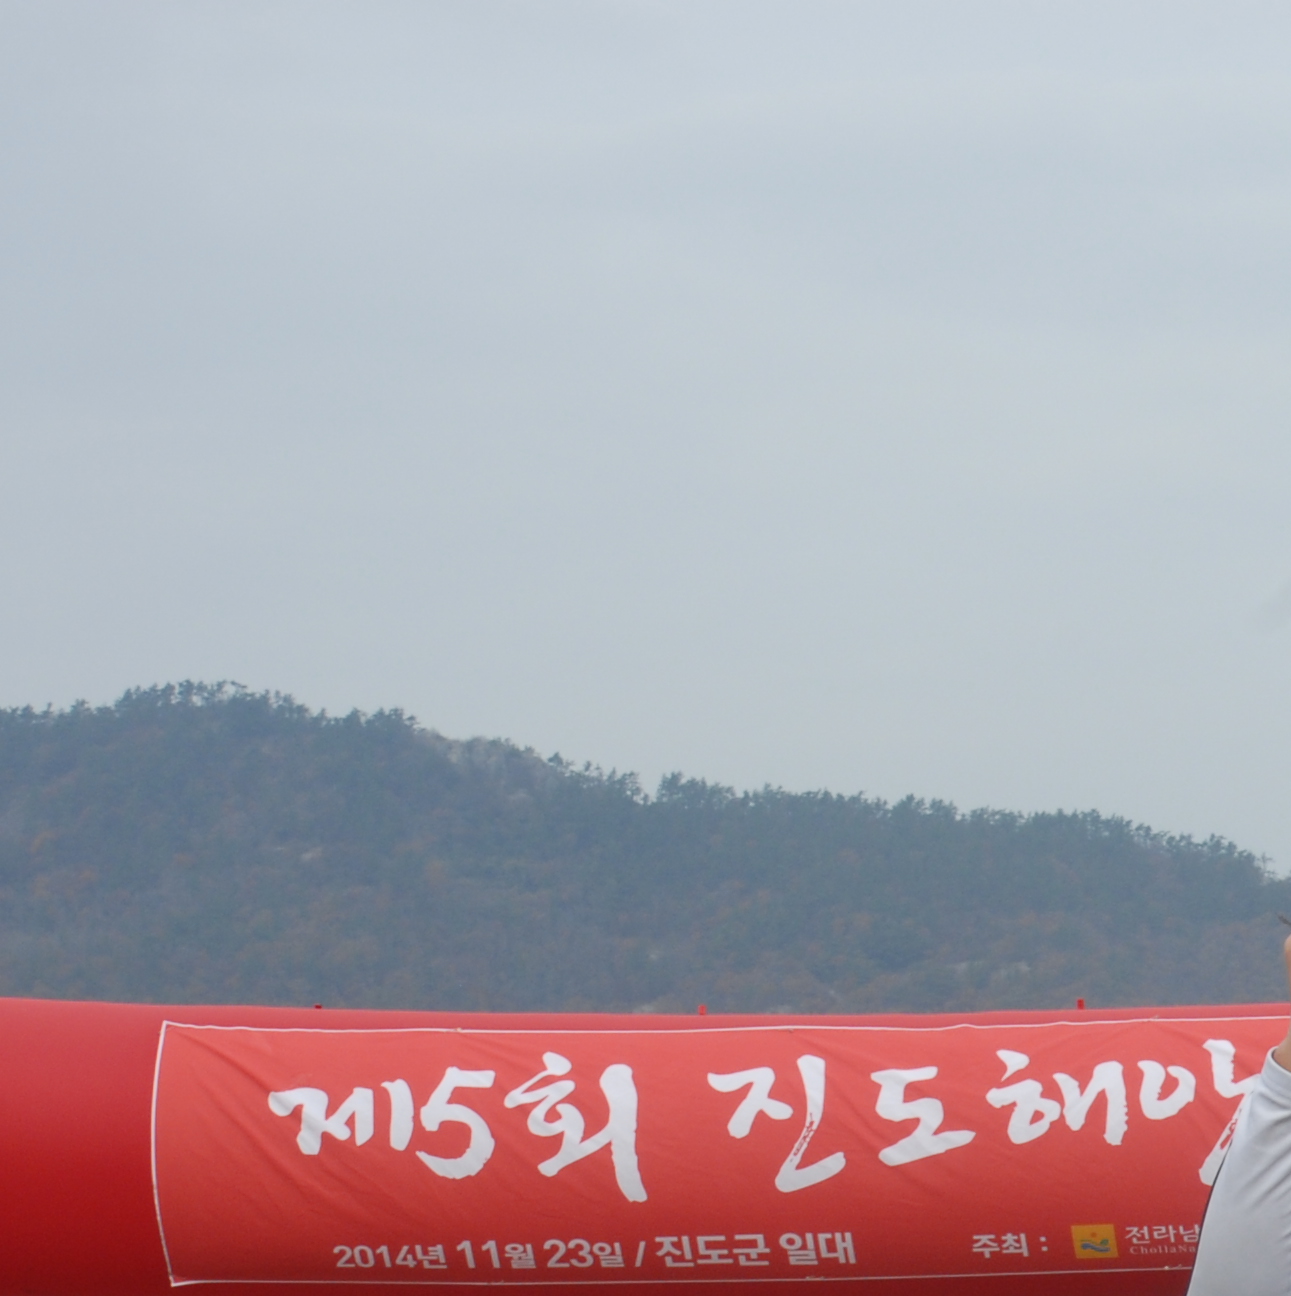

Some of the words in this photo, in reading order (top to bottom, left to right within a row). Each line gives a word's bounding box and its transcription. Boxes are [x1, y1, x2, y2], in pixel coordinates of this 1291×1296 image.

[267, 1052, 648, 1202] 제5회
[333, 1244, 448, 1269] 2014년
[456, 1239, 536, 1270] 11월
[546, 1238, 625, 1269] 23일
[655, 1234, 770, 1268] 진도군
[779, 1231, 857, 1266] 일대
[972, 1232, 1030, 1259] 주최
